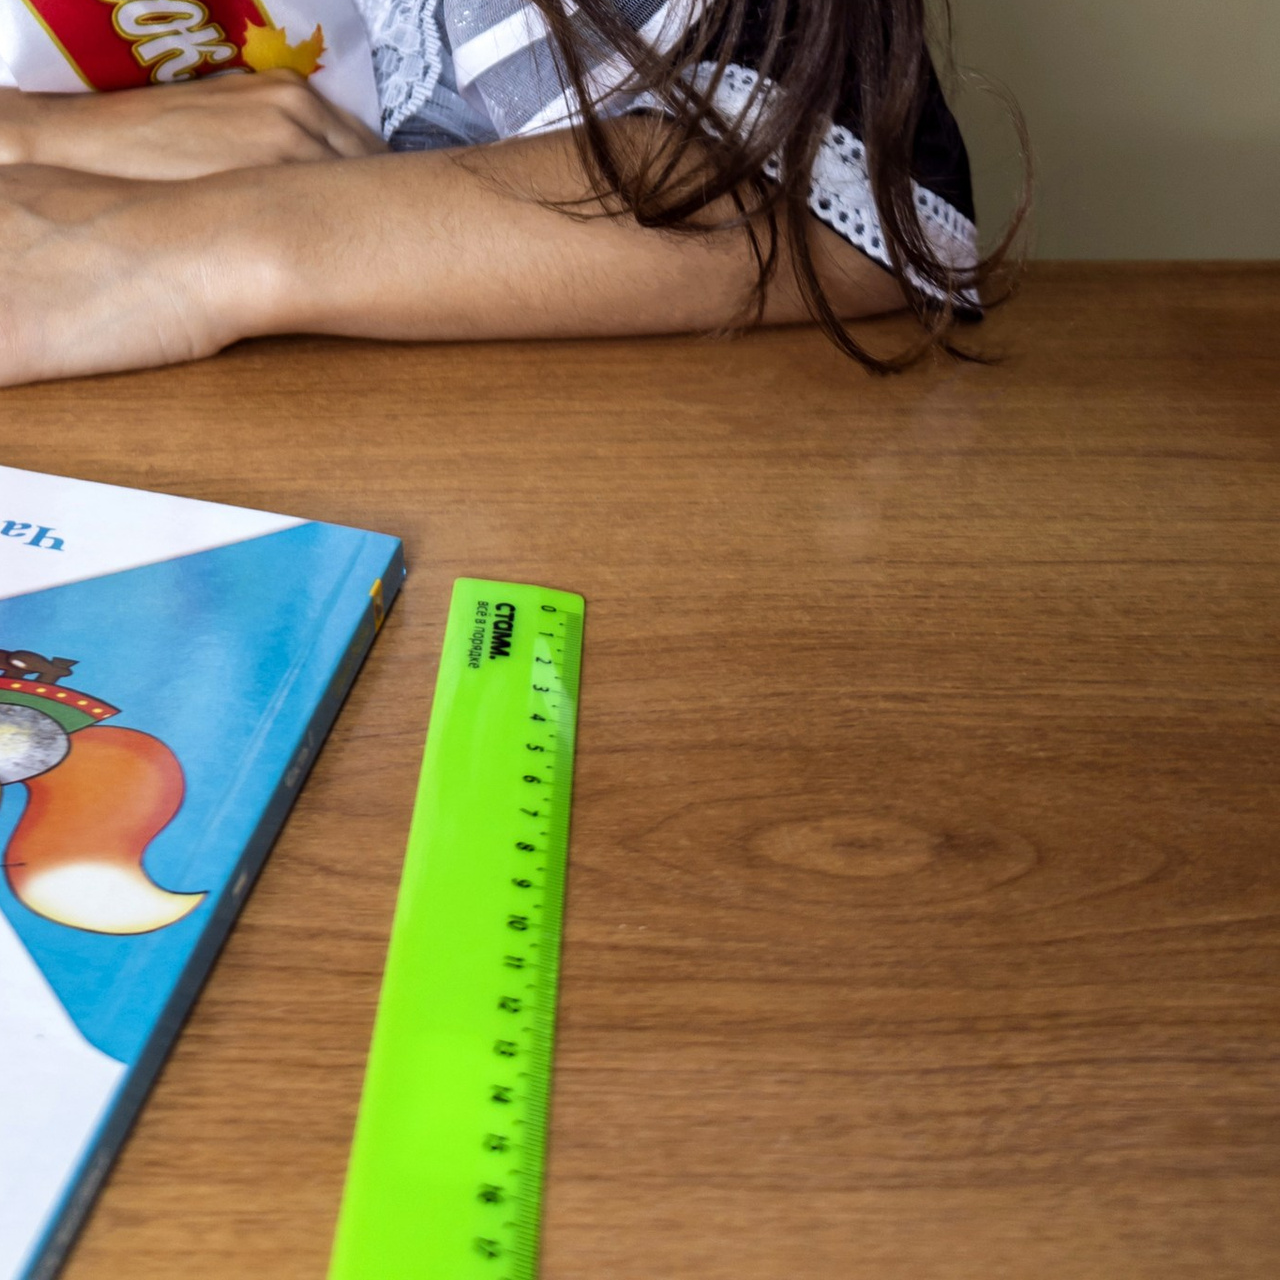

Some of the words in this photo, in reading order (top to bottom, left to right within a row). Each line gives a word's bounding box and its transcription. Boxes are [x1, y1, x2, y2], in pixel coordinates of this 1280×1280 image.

[475, 599, 491, 619] всё
[541, 604, 557, 614] 0
[538, 631, 555, 639] 1
[468, 625, 486, 670] порядке
[535, 655, 553, 666] 2
[532, 684, 550, 694] 3
[529, 712, 547, 723] 4
[525, 742, 545, 754] 5
[522, 774, 542, 786] 6
[519, 807, 539, 818] 7
[514, 841, 536, 853] 8
[511, 877, 533, 889] 9
[506, 913, 530, 932] 10
[503, 954, 526, 970] 11
